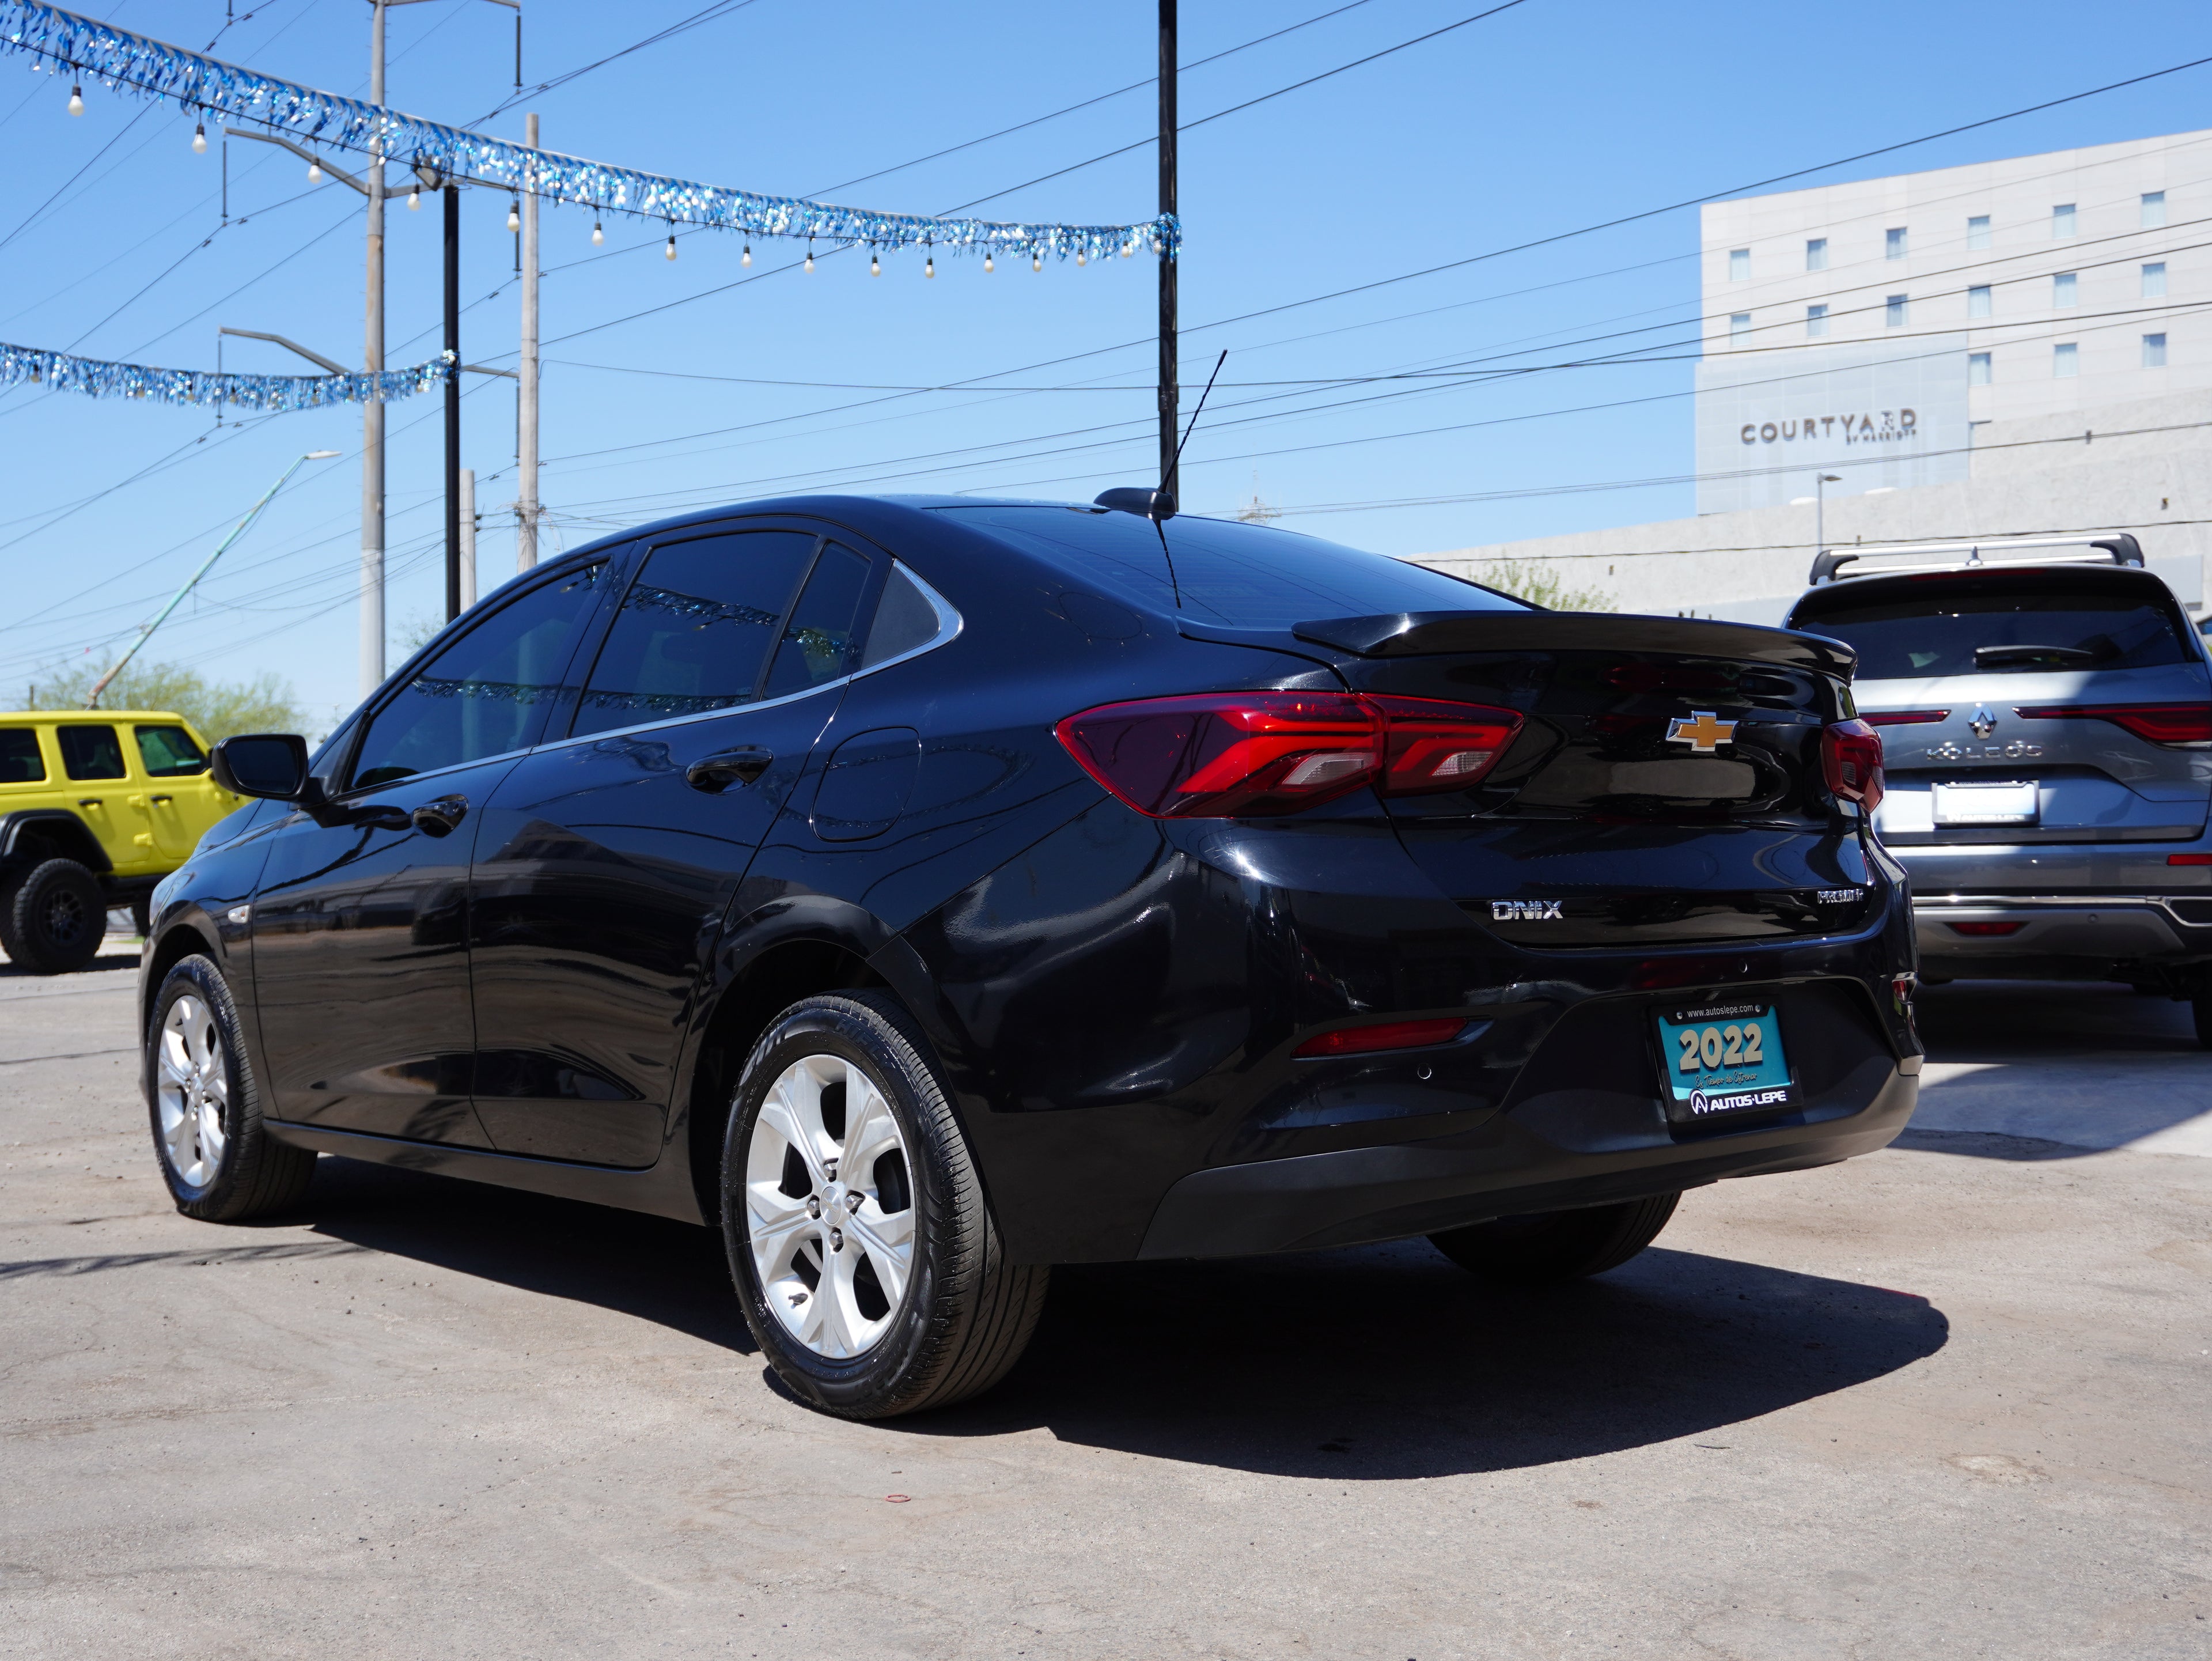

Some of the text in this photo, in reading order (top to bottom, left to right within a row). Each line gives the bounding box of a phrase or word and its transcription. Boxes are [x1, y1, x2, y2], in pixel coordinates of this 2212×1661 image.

[1741, 408, 1916, 444] COURTYARD
[1927, 745, 2043, 760] KOLEOS
[1817, 888, 1864, 904] PREMIER
[1491, 900, 1563, 920] ONIX
[1687, 1005, 1754, 1018] www.autoslepe.com
[1679, 1023, 1763, 1070] 2022
[1695, 1070, 1758, 1088] Es Tiempo de Estrenar
